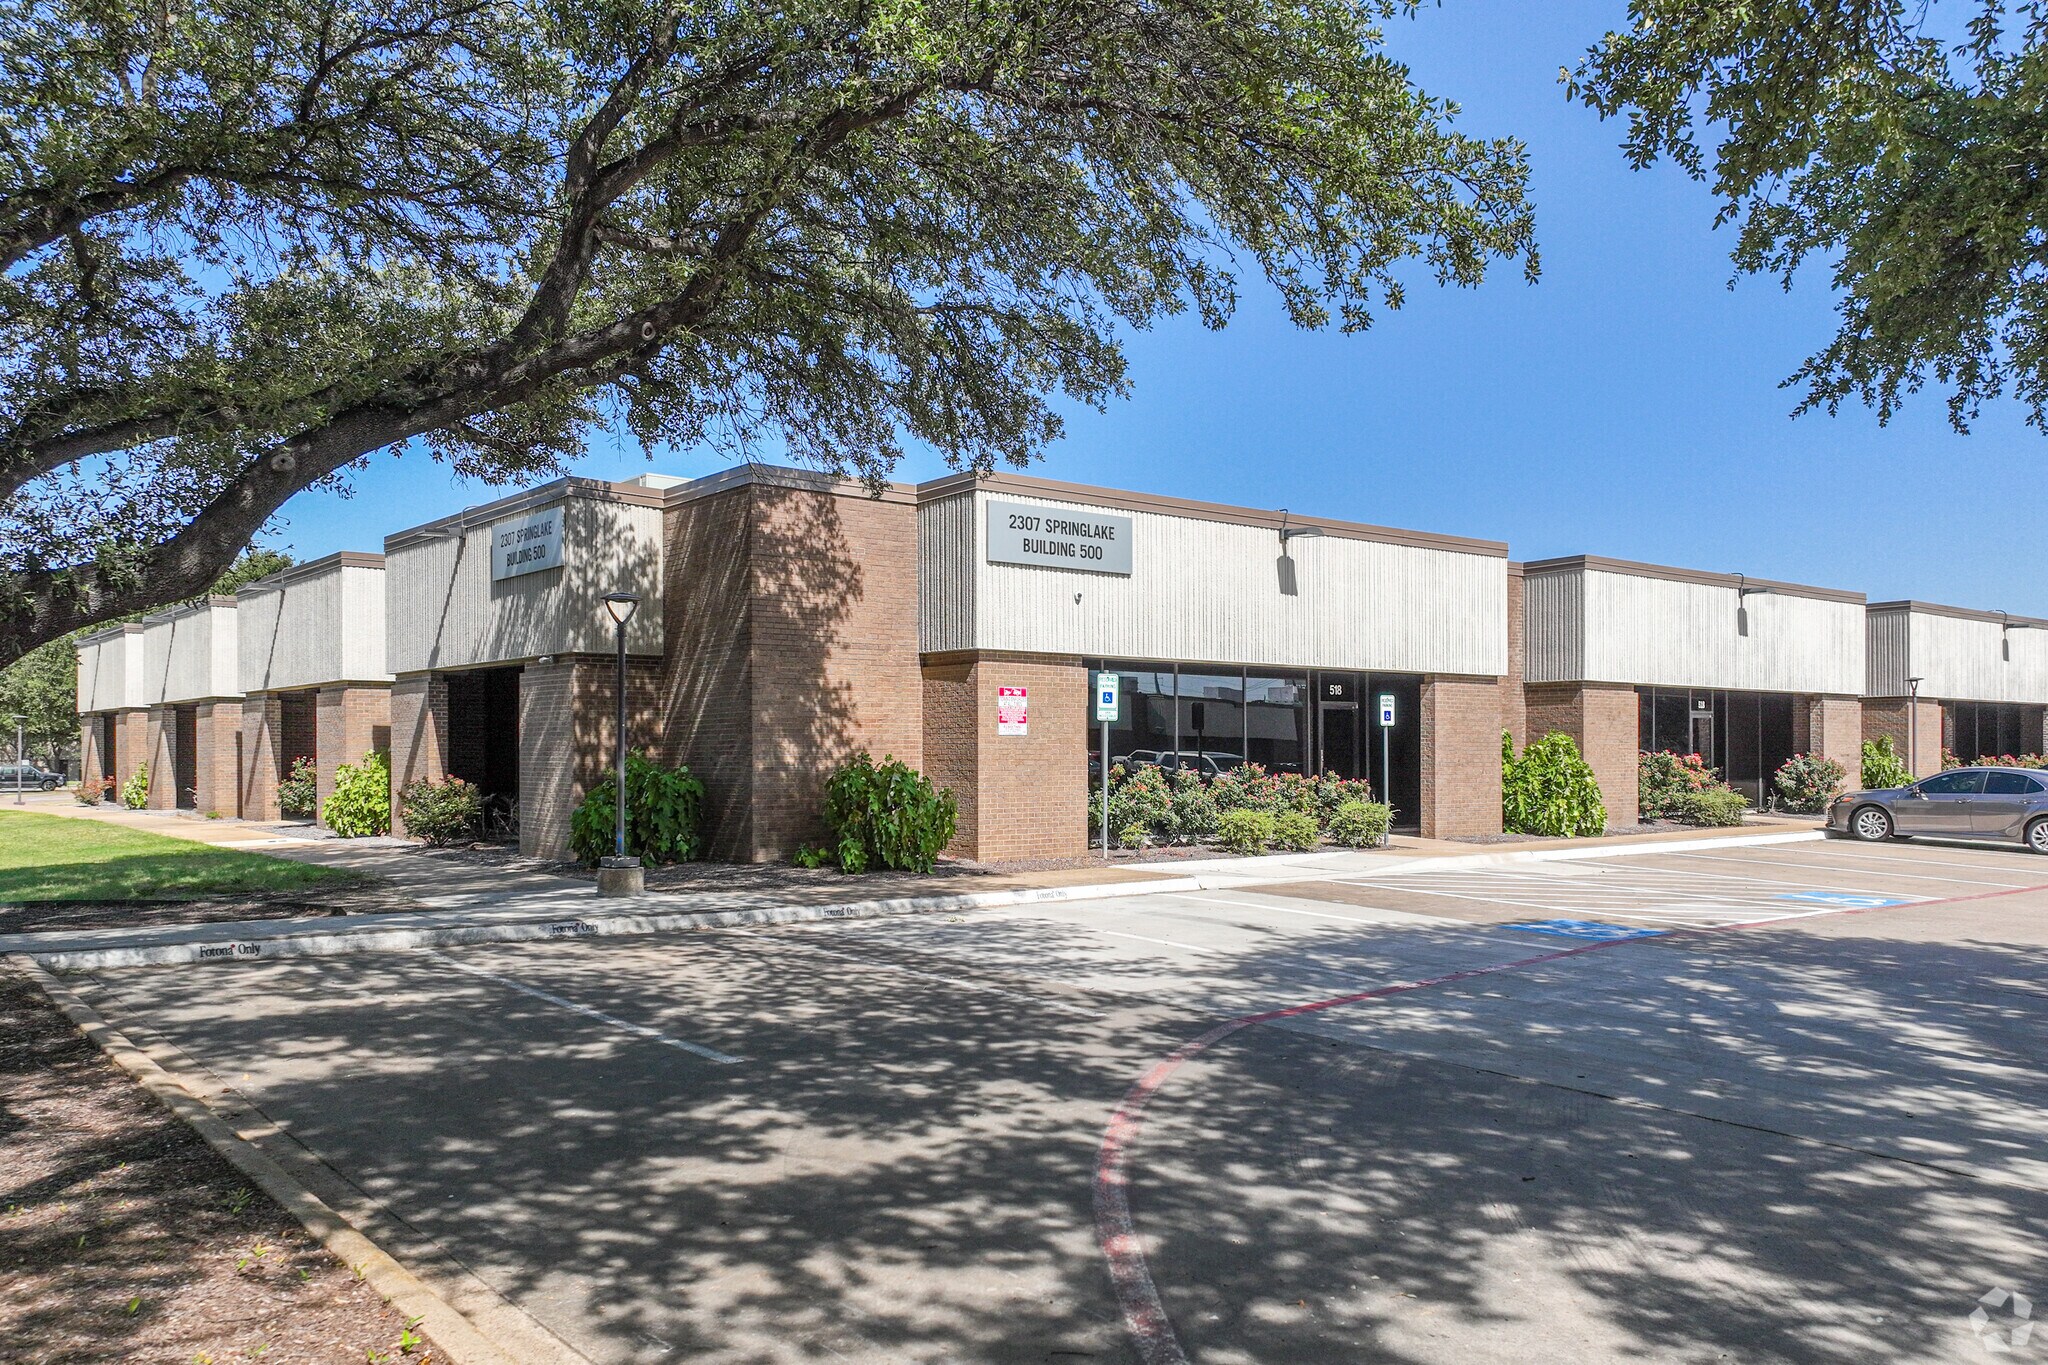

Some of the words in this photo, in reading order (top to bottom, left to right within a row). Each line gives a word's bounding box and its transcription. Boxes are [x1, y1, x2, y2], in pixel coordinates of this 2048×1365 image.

[500, 531, 515, 548] 2307
[516, 520, 552, 544] SPRINGLAKE
[1009, 514, 1041, 532] 2307
[1045, 518, 1115, 541] SPRINGLAKE
[506, 547, 532, 567] BUILDING
[533, 544, 546, 561] 500
[1023, 538, 1075, 558] BUILDING
[1080, 545, 1103, 560] 500
[1329, 684, 1342, 695] 518
[238, 942, 261, 957] Only
